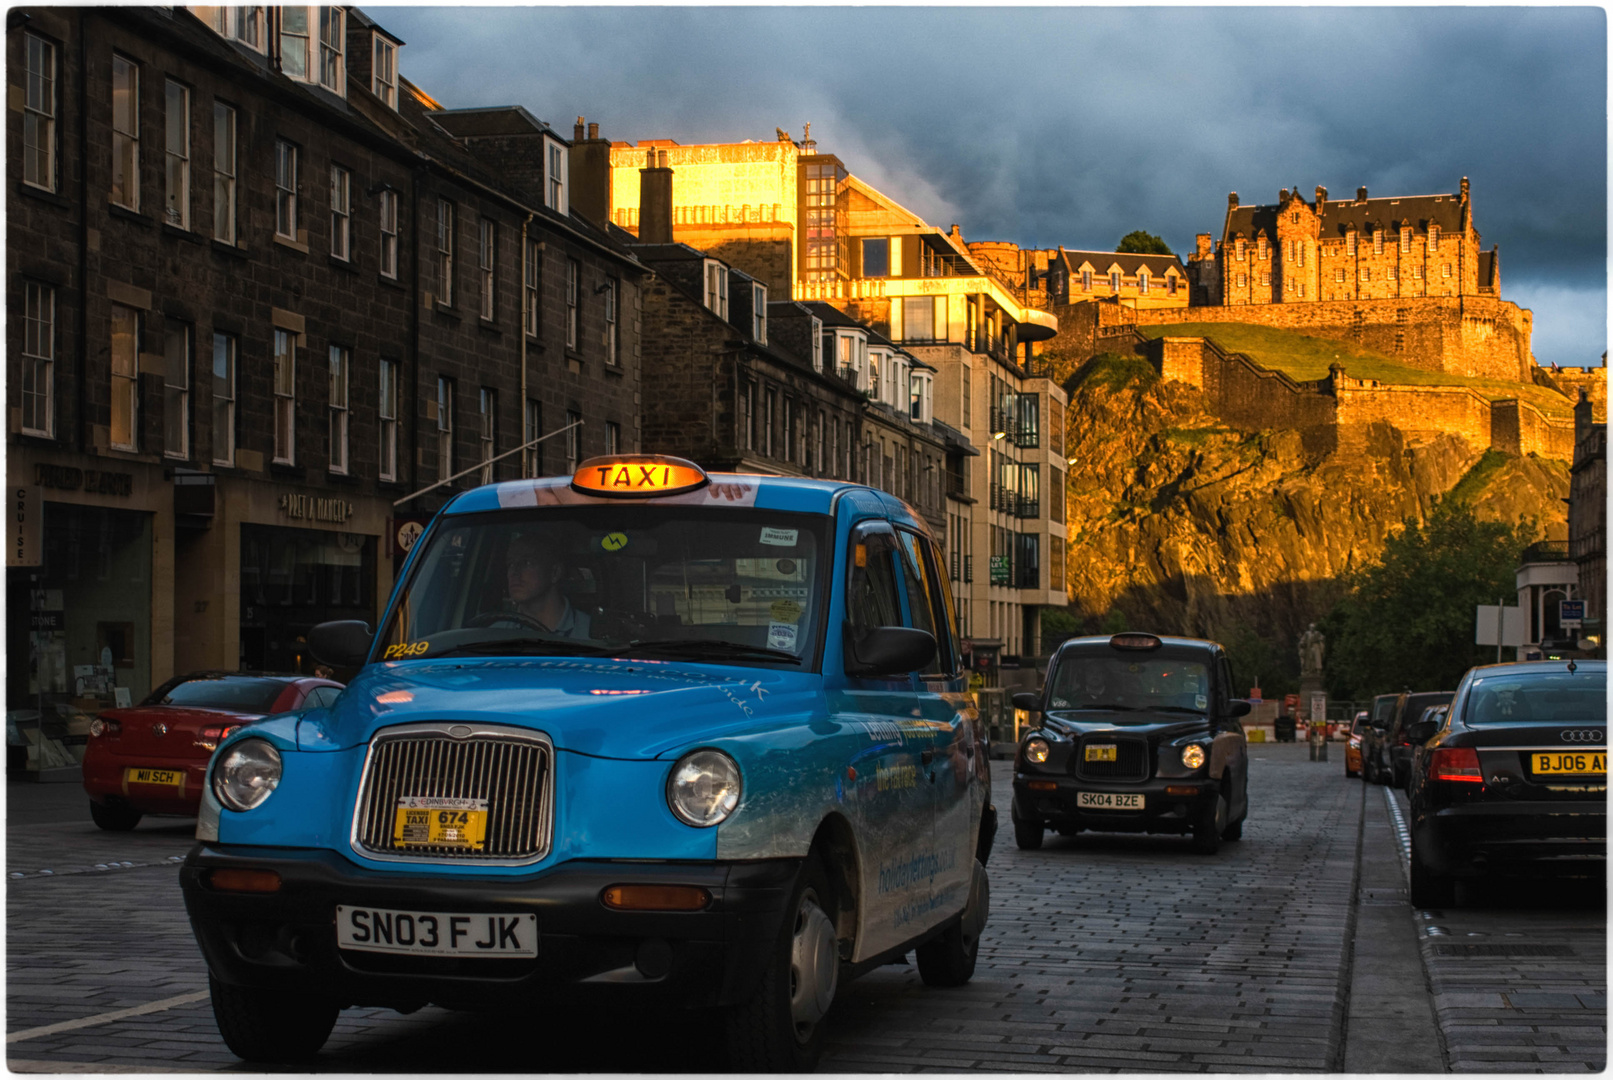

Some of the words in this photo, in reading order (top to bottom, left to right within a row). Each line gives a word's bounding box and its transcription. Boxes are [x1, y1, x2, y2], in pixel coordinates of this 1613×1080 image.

[597, 466, 670, 486] TAXI
[288, 493, 306, 518] PRET
[309, 497, 314, 520] A
[317, 498, 346, 523] MANGER
[16, 489, 26, 559] CRUISE
[32, 616, 57, 626] STONE
[384, 641, 430, 660] P249
[861, 721, 903, 747] Letting
[1539, 756, 1585, 771] BJ06
[1592, 756, 1606, 770] A
[152, 773, 174, 783] SCH
[876, 760, 890, 792] the
[890, 762, 902, 789] rat
[902, 765, 917, 788] race
[1082, 794, 1112, 806] SK04
[1115, 796, 1138, 806] BZE
[406, 816, 428, 824] TAXI
[439, 812, 468, 824] 674
[351, 909, 440, 948] SN03
